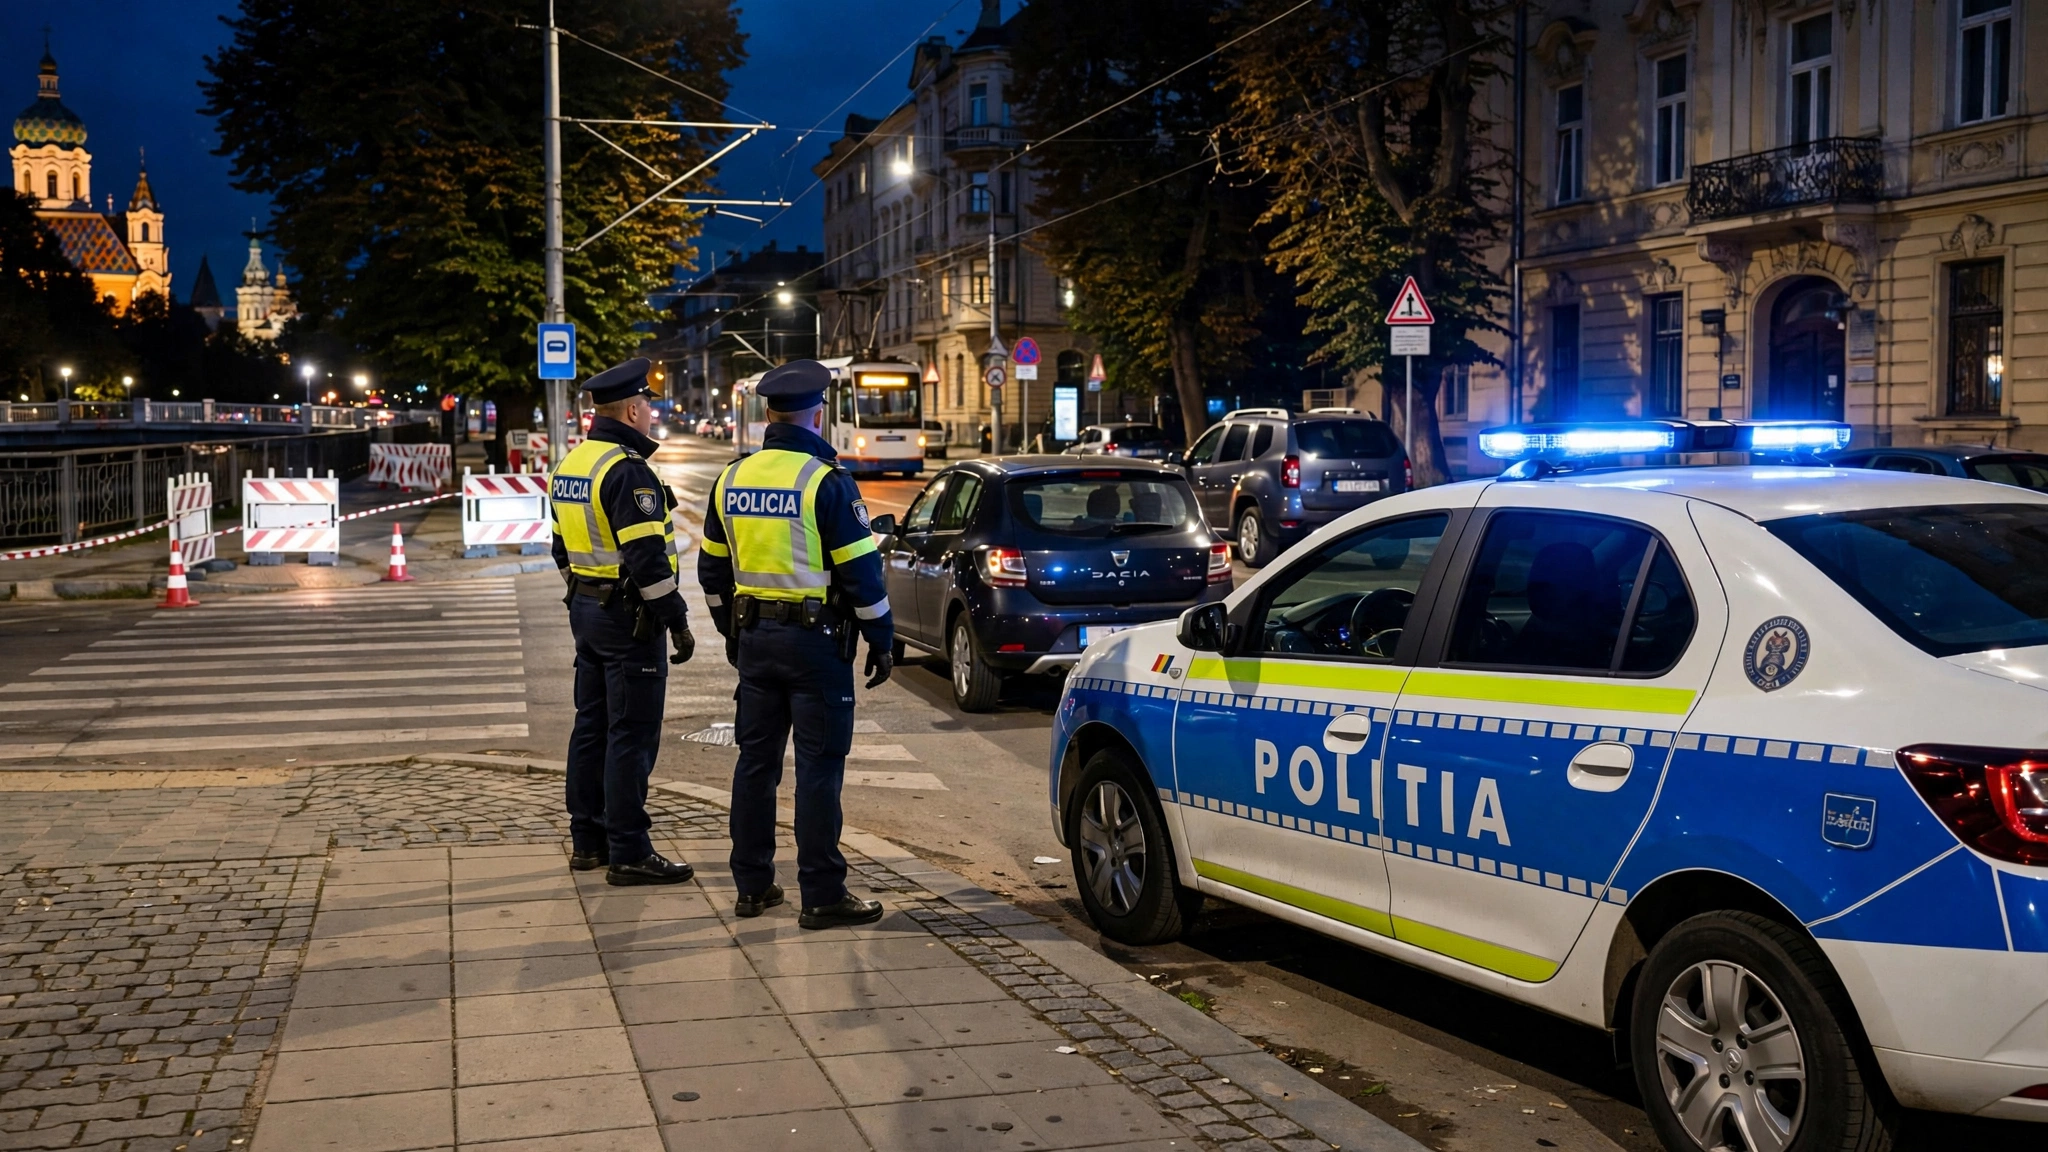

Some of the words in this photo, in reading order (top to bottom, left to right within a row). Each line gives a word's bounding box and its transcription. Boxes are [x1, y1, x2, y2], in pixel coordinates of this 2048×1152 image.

[553, 479, 589, 501] POLICIA
[727, 491, 798, 515] POLICIA
[1092, 570, 1150, 578] DACIA
[1255, 738, 1512, 847] POLITIA
